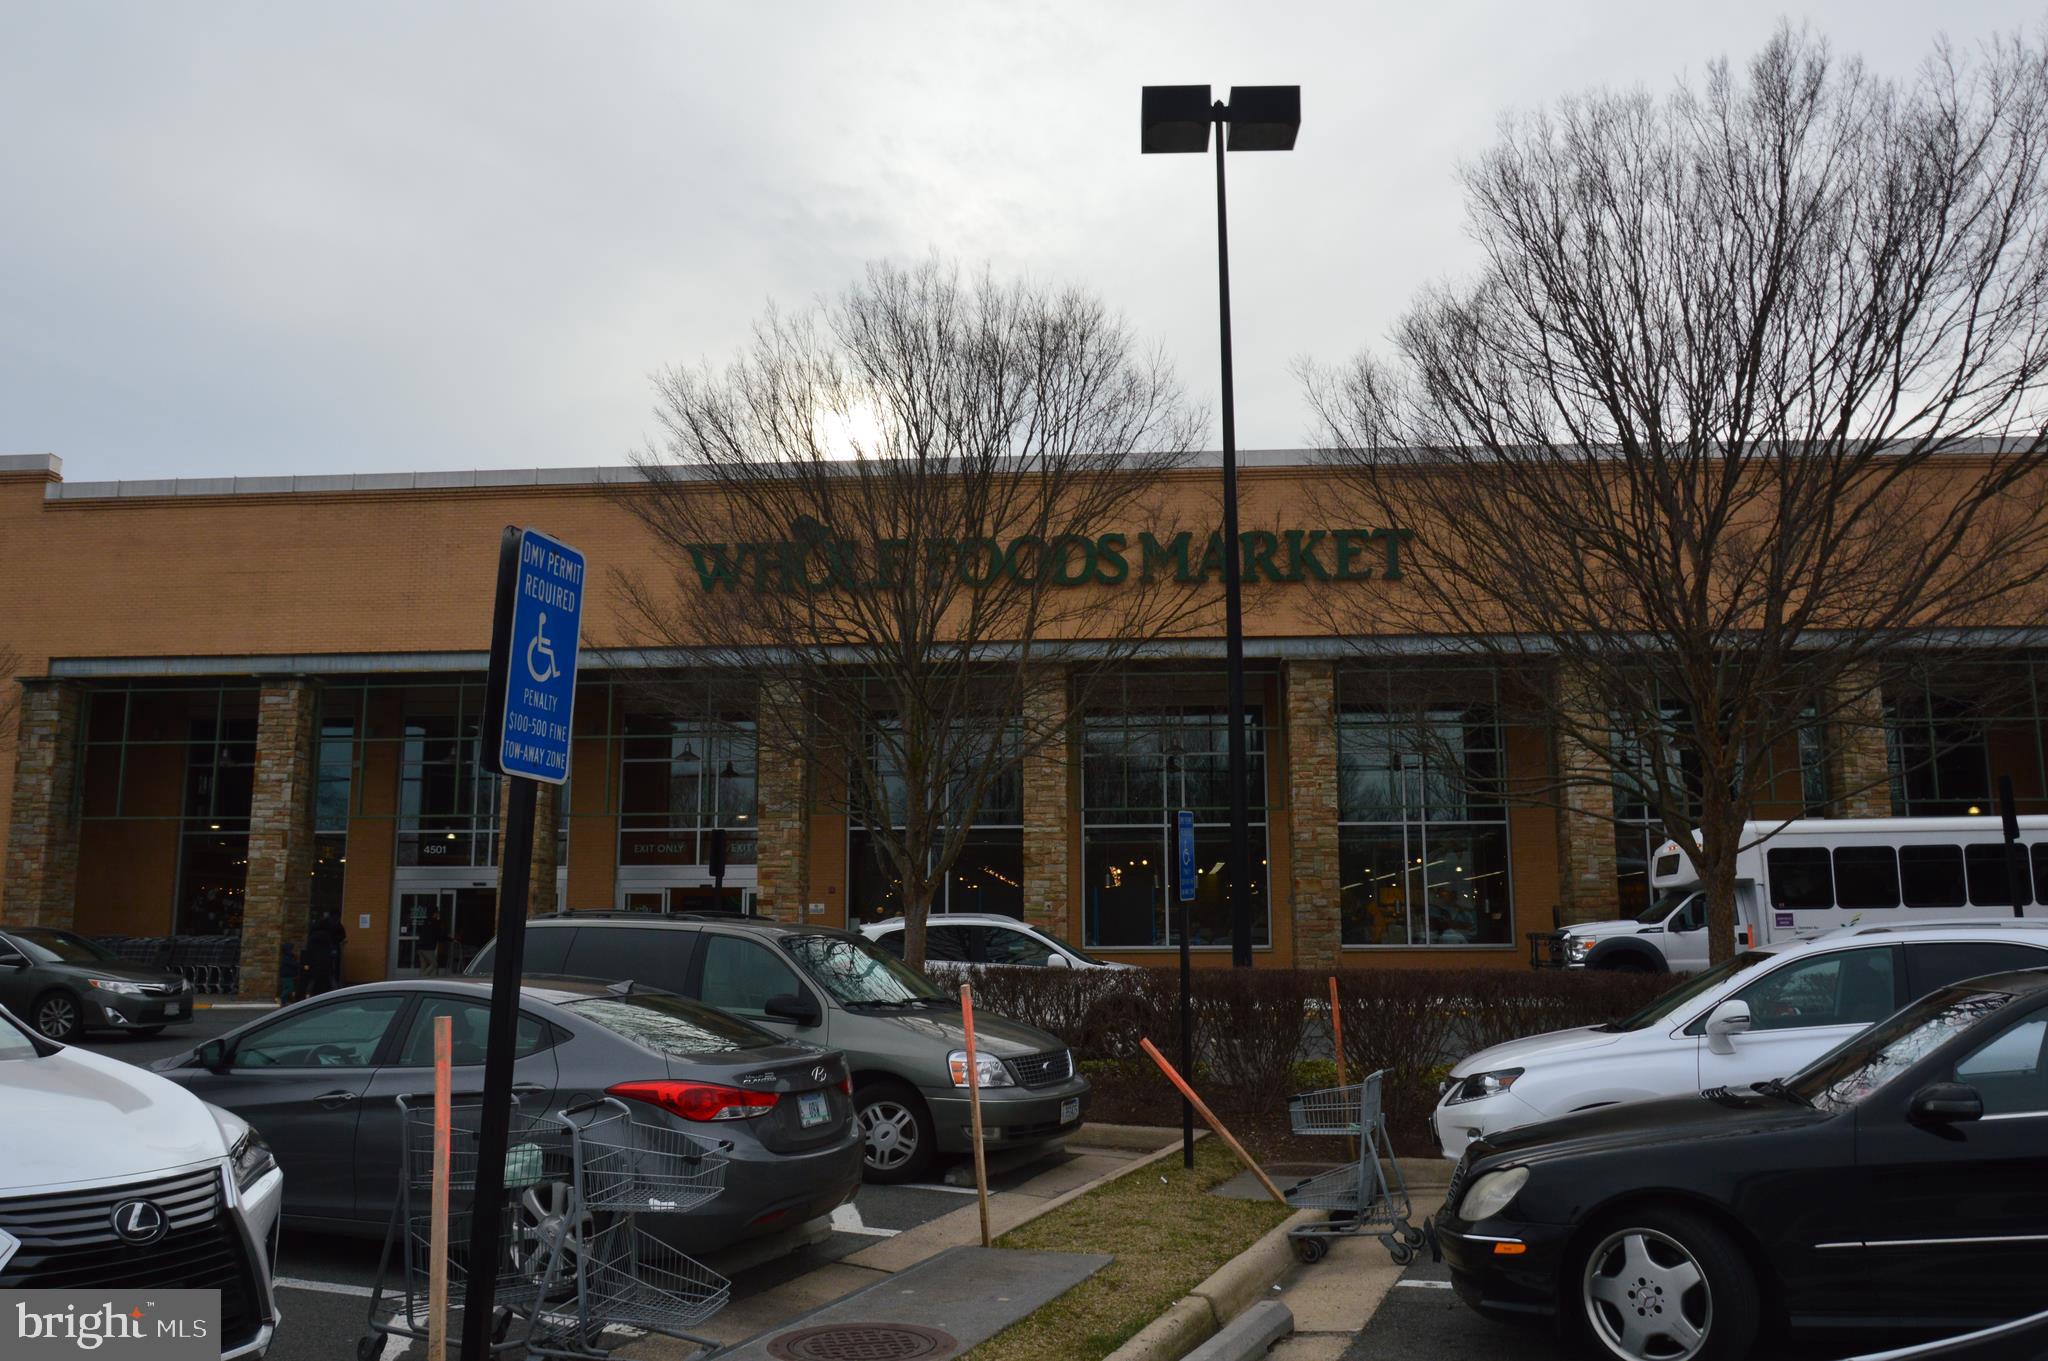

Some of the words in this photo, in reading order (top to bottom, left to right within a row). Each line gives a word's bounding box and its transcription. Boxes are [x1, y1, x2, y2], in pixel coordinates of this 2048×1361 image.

[523, 541, 546, 569] DMV
[548, 551, 582, 585] PERMIT
[920, 532, 1130, 590] FOODS
[1137, 527, 1416, 586] MARKET
[525, 575, 575, 613] REQUIRED
[523, 688, 558, 713] PENALTY
[508, 711, 547, 735] $100-500
[549, 724, 567, 742] FINE
[504, 740, 545, 766] TOW-AWAY
[545, 750, 566, 770] ZONE
[423, 844, 447, 854] 4501
[633, 843, 655, 854] EXIT
[656, 843, 684, 854] ONLY
[730, 842, 753, 853] EXIT
